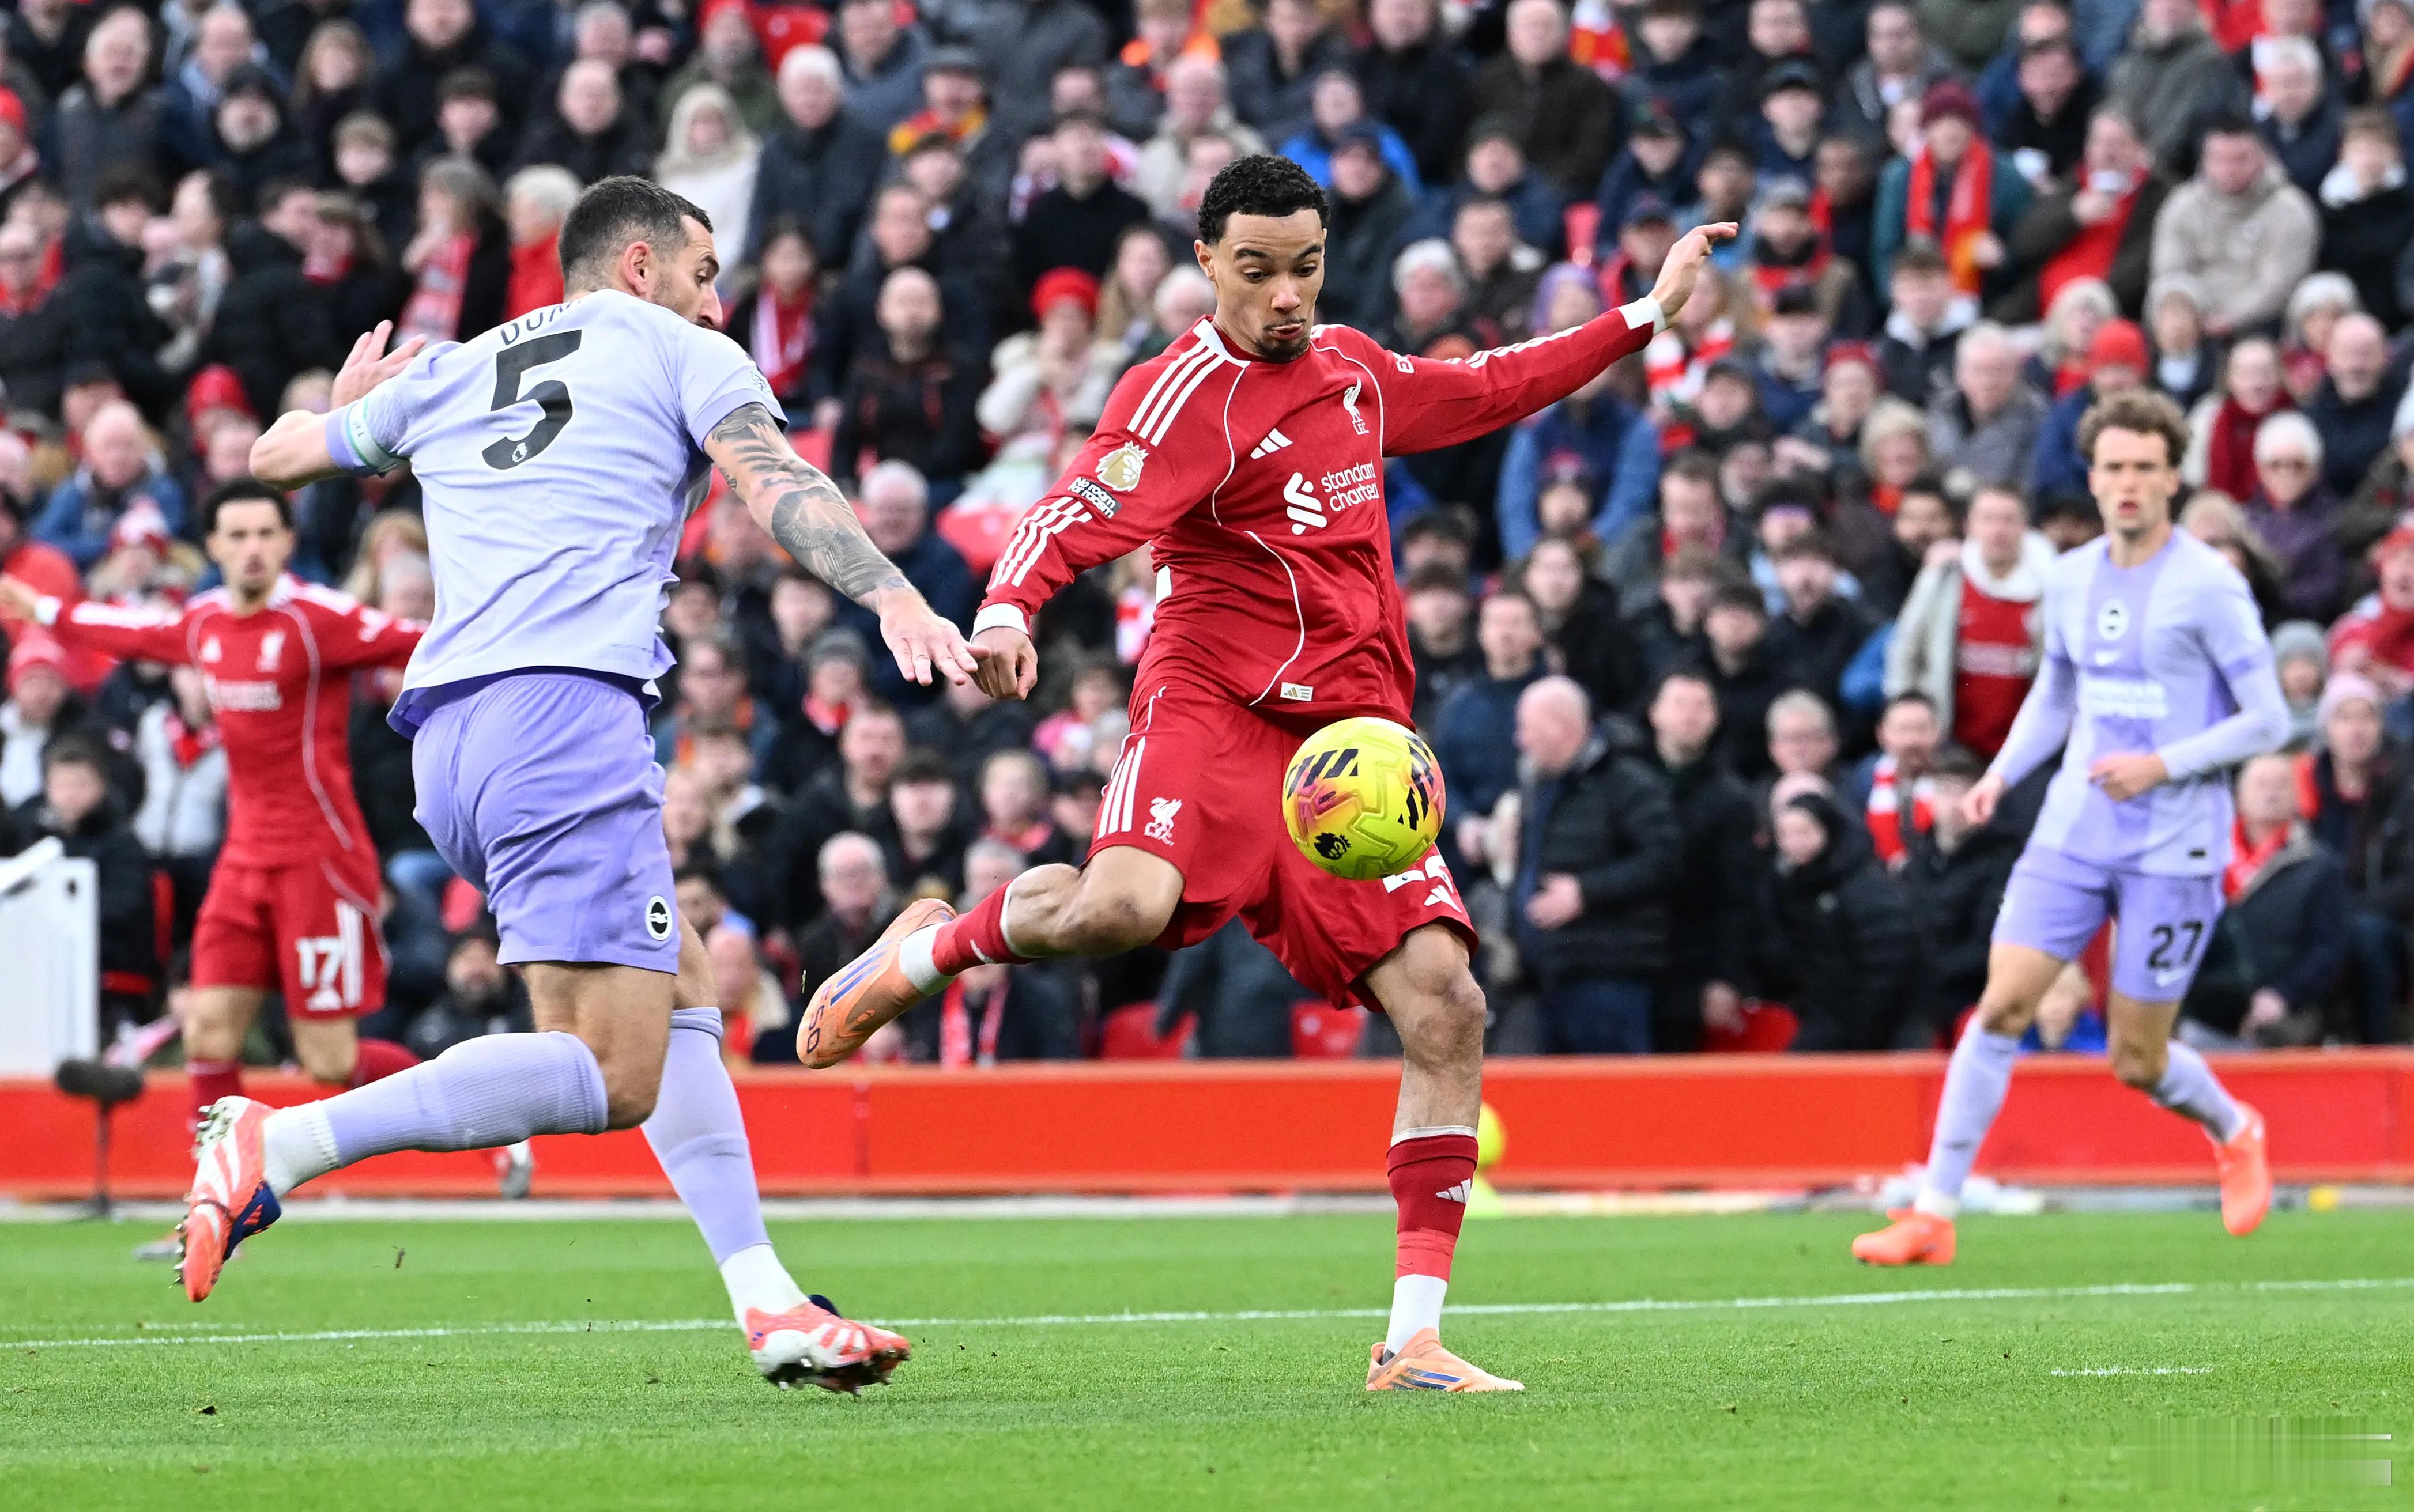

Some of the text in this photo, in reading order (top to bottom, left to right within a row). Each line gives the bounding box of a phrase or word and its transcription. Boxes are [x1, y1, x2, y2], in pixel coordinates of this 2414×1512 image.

[500, 300, 582, 346] DU
[481, 329, 582, 470] 5
[1087, 483, 1117, 509] room
[1321, 459, 1376, 493] standard
[1081, 489, 1115, 519] racism
[295, 936, 345, 989] 17
[2147, 919, 2204, 970] 27
